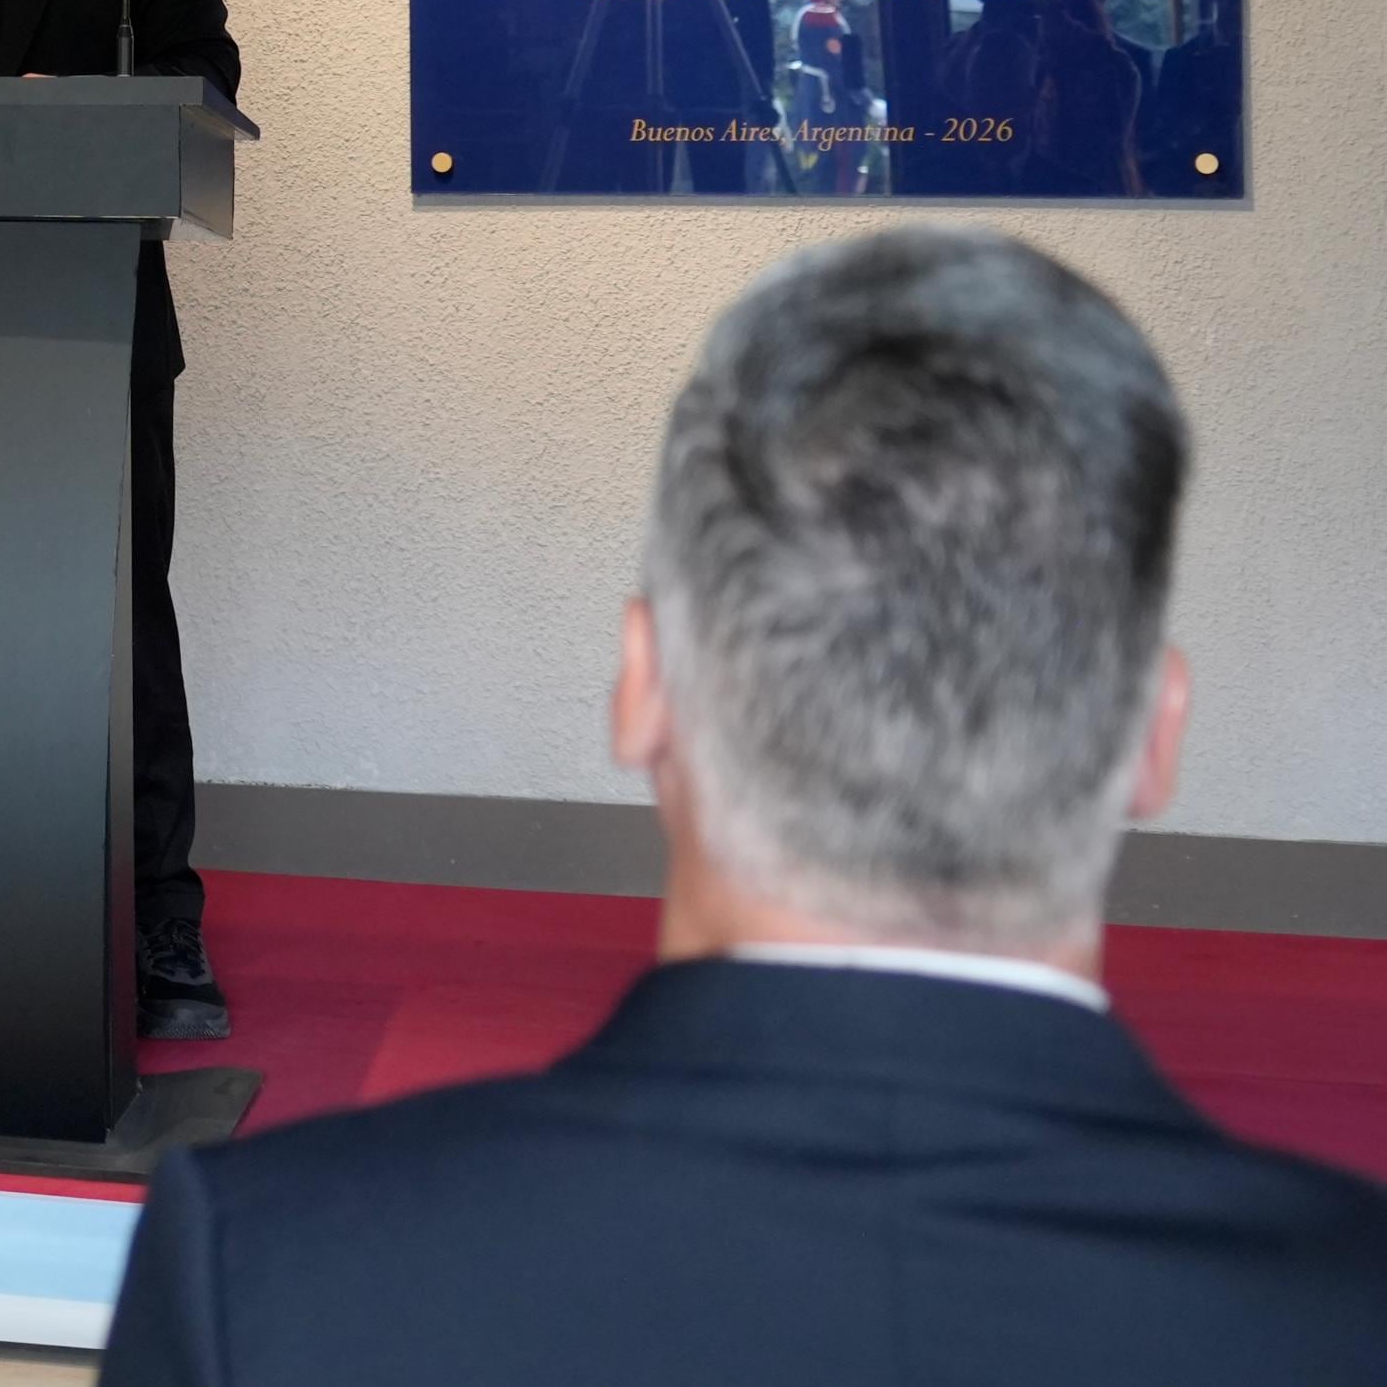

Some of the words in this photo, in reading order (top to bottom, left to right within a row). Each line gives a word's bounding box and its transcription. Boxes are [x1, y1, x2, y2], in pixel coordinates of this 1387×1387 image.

[629, 118, 715, 143] Buenos
[719, 119, 787, 146] Aires,
[791, 119, 915, 151] Argentina
[940, 117, 1015, 143] 2026
